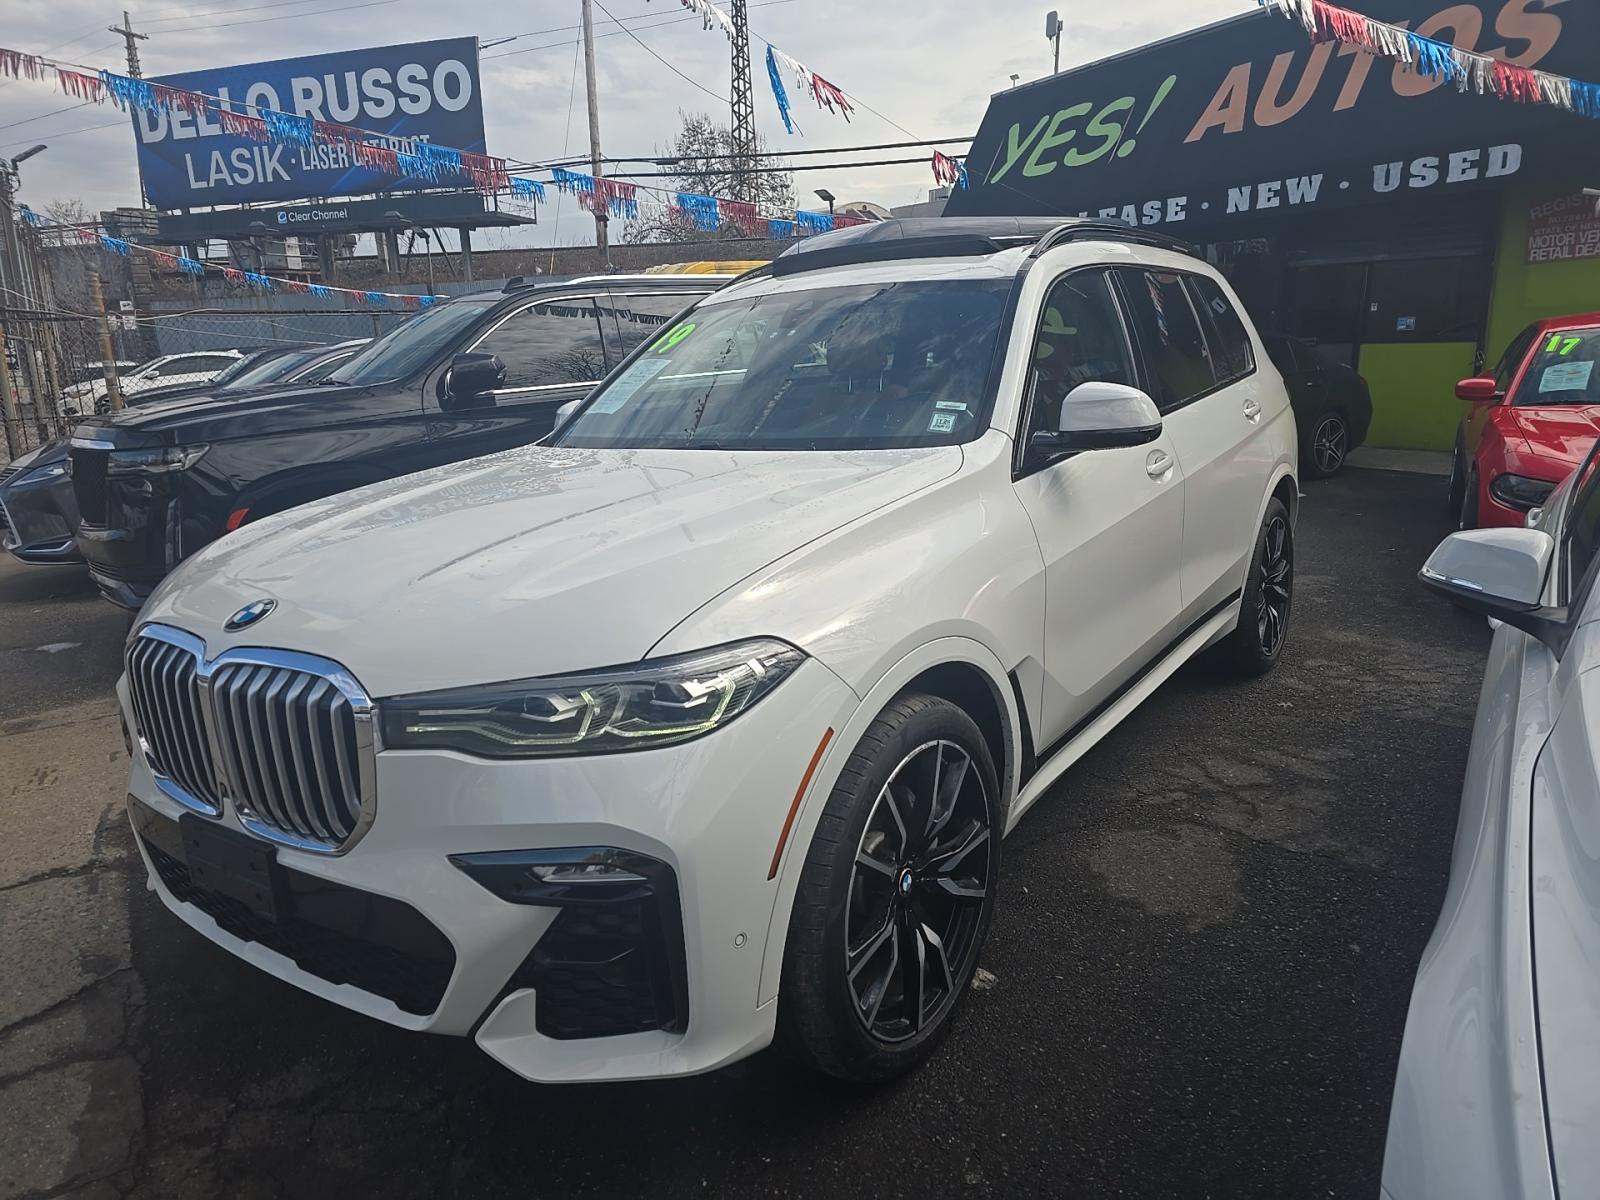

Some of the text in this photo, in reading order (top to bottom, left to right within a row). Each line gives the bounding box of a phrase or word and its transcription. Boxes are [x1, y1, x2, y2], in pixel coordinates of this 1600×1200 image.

[135, 59, 472, 144] DELLO RUSSO
[990, 0, 1577, 184] YES! AUTOS
[185, 144, 291, 189] LASIK
[300, 143, 349, 171] LASER
[1078, 143, 1522, 227] ASE NEW USED
[288, 208, 348, 222] Clear Channel
[1529, 232, 1575, 249] MOTOR
[1530, 246, 1573, 261] RETAIL
[1545, 335, 1581, 355] 17
